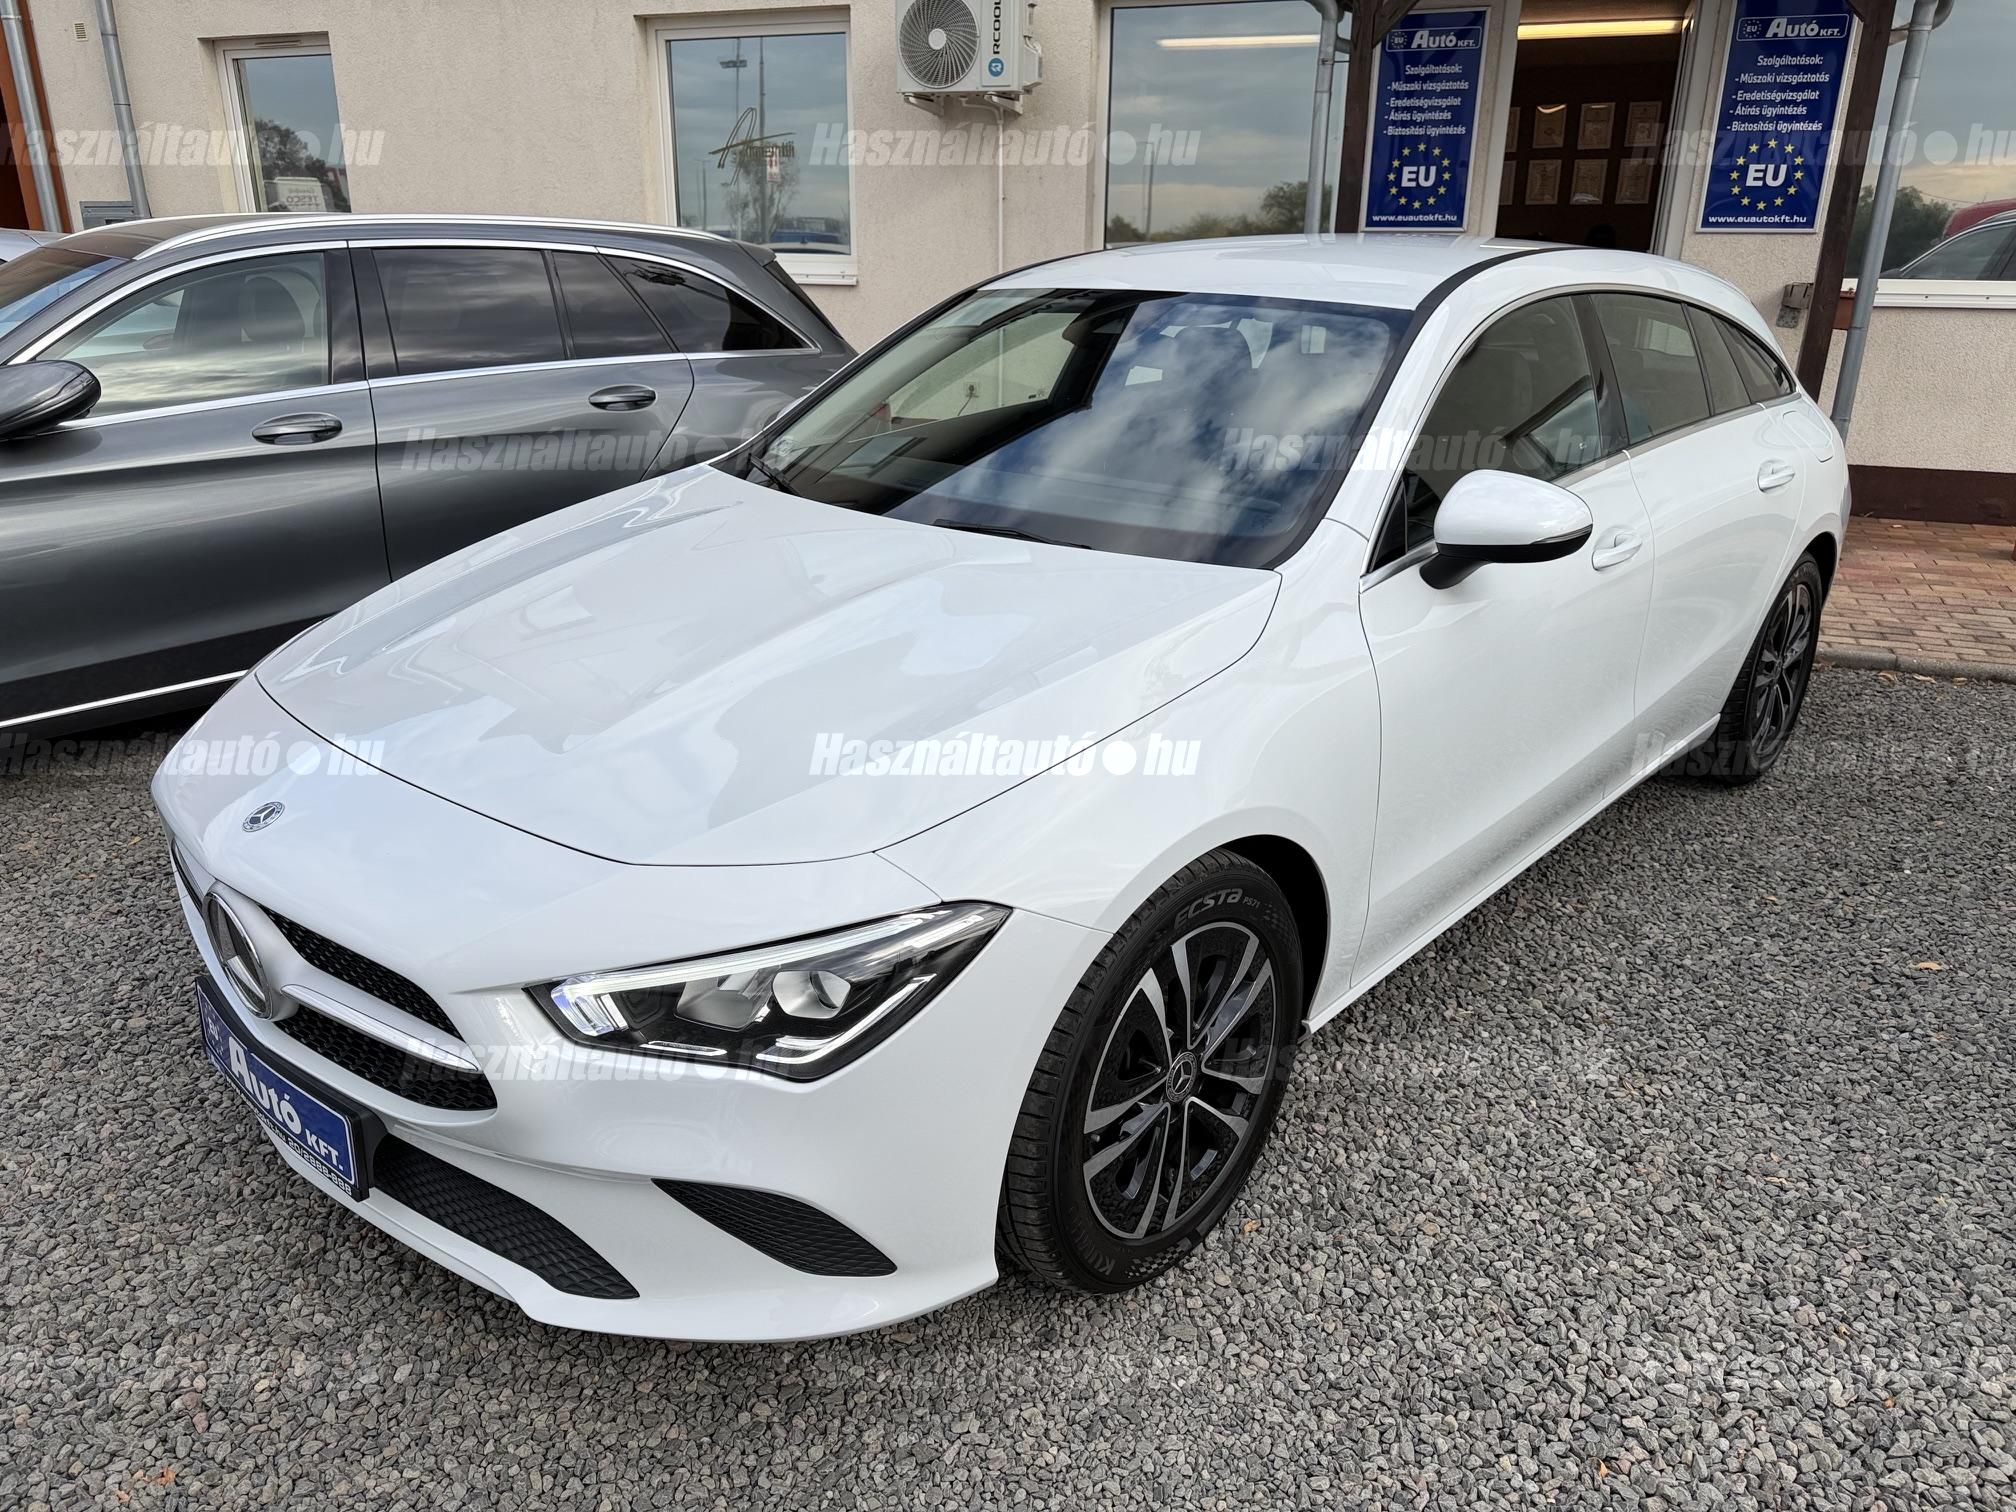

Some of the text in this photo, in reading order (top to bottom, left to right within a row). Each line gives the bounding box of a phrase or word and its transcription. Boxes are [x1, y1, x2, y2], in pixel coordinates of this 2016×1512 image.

[1766, 18, 1819, 37] Autó
[1819, 28, 1840, 36] KFT.
[1411, 30, 1456, 48] Autó
[1757, 54, 1823, 68] Szolgáltatások:
[1405, 64, 1462, 76] Szolgáltatások:
[1776, 72, 1830, 85] vizsgáztatás
[1422, 80, 1469, 92] vizsgáztatás
[1412, 110, 1452, 122] ügyintézés
[1762, 104, 1807, 117] ügyintézés
[1426, 125, 1466, 137] ügyintézés
[1777, 121, 1822, 133] ügyintézés
[1401, 166, 1437, 188] EU
[1746, 164, 1787, 187] EU
[1372, 214, 1457, 222] www.euautokft.hu
[1708, 215, 1807, 223] www.euautokft.hu
[229, 1036, 301, 1134] Autó
[305, 1128, 344, 1171] KFT.
